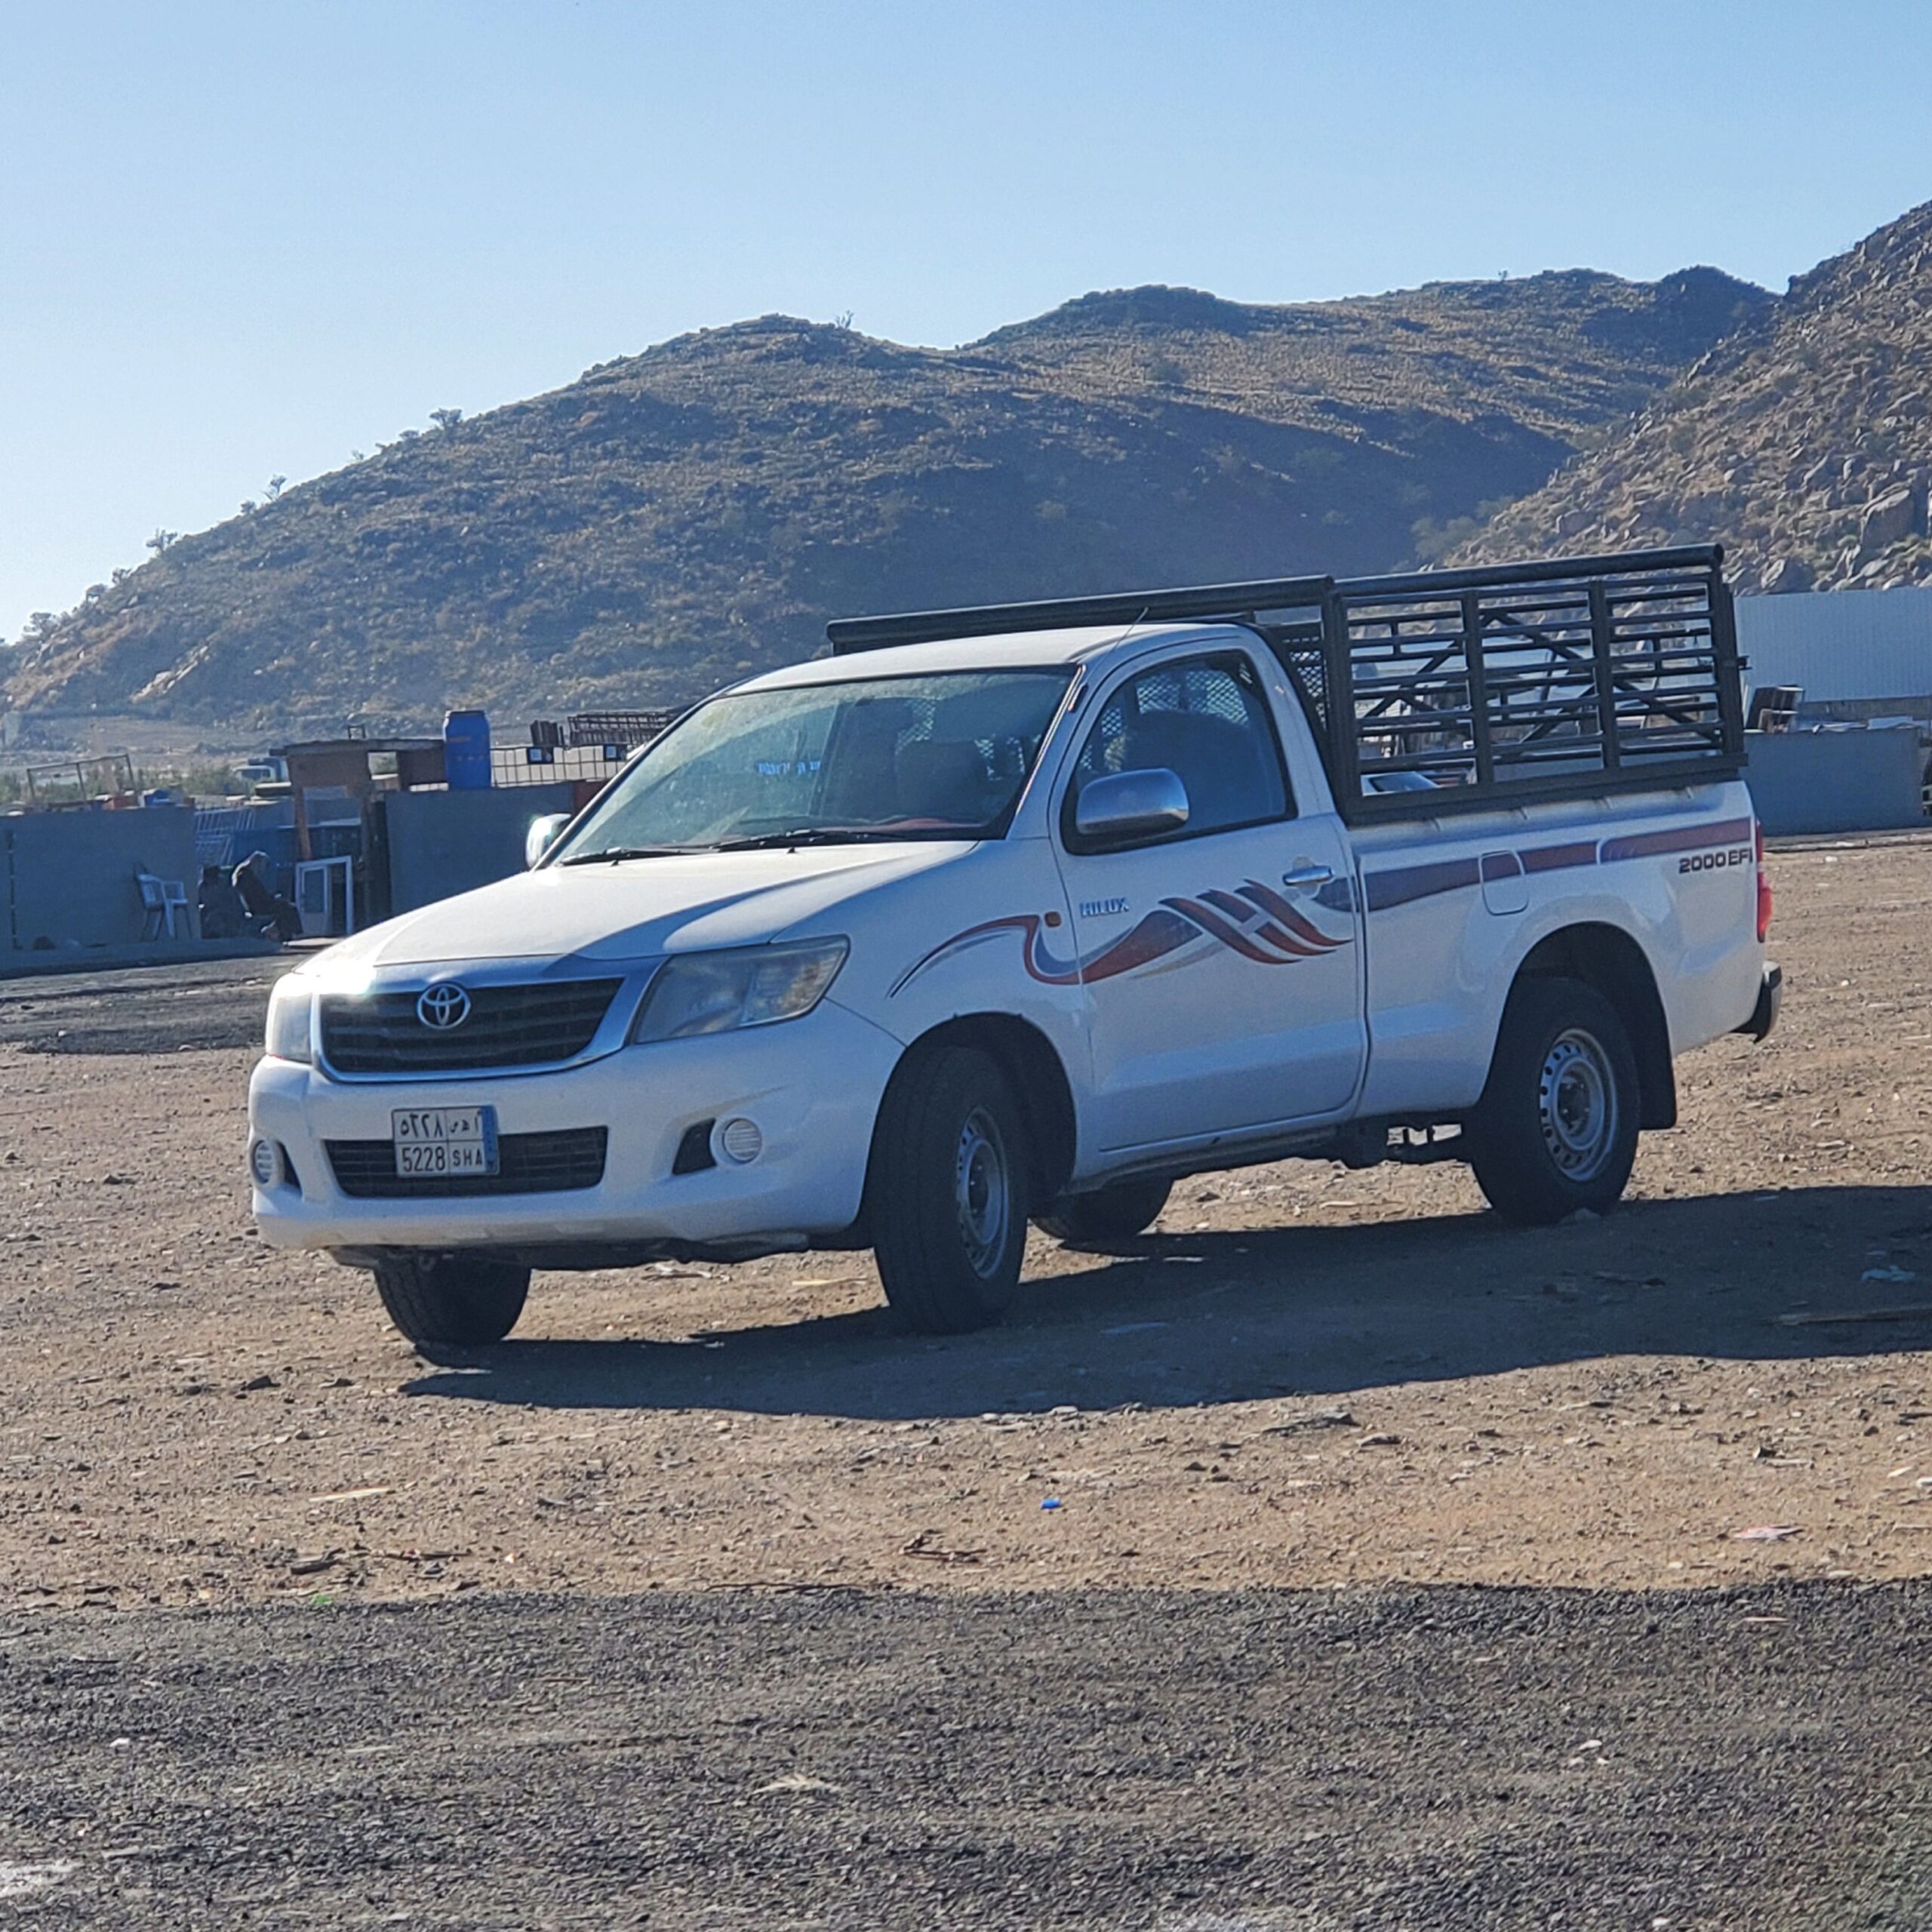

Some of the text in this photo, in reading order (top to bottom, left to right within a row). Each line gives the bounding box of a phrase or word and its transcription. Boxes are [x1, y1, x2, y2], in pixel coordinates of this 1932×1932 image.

[1079, 897, 1129, 918] HILUX
[402, 1146, 483, 1173] 5228 SHA
